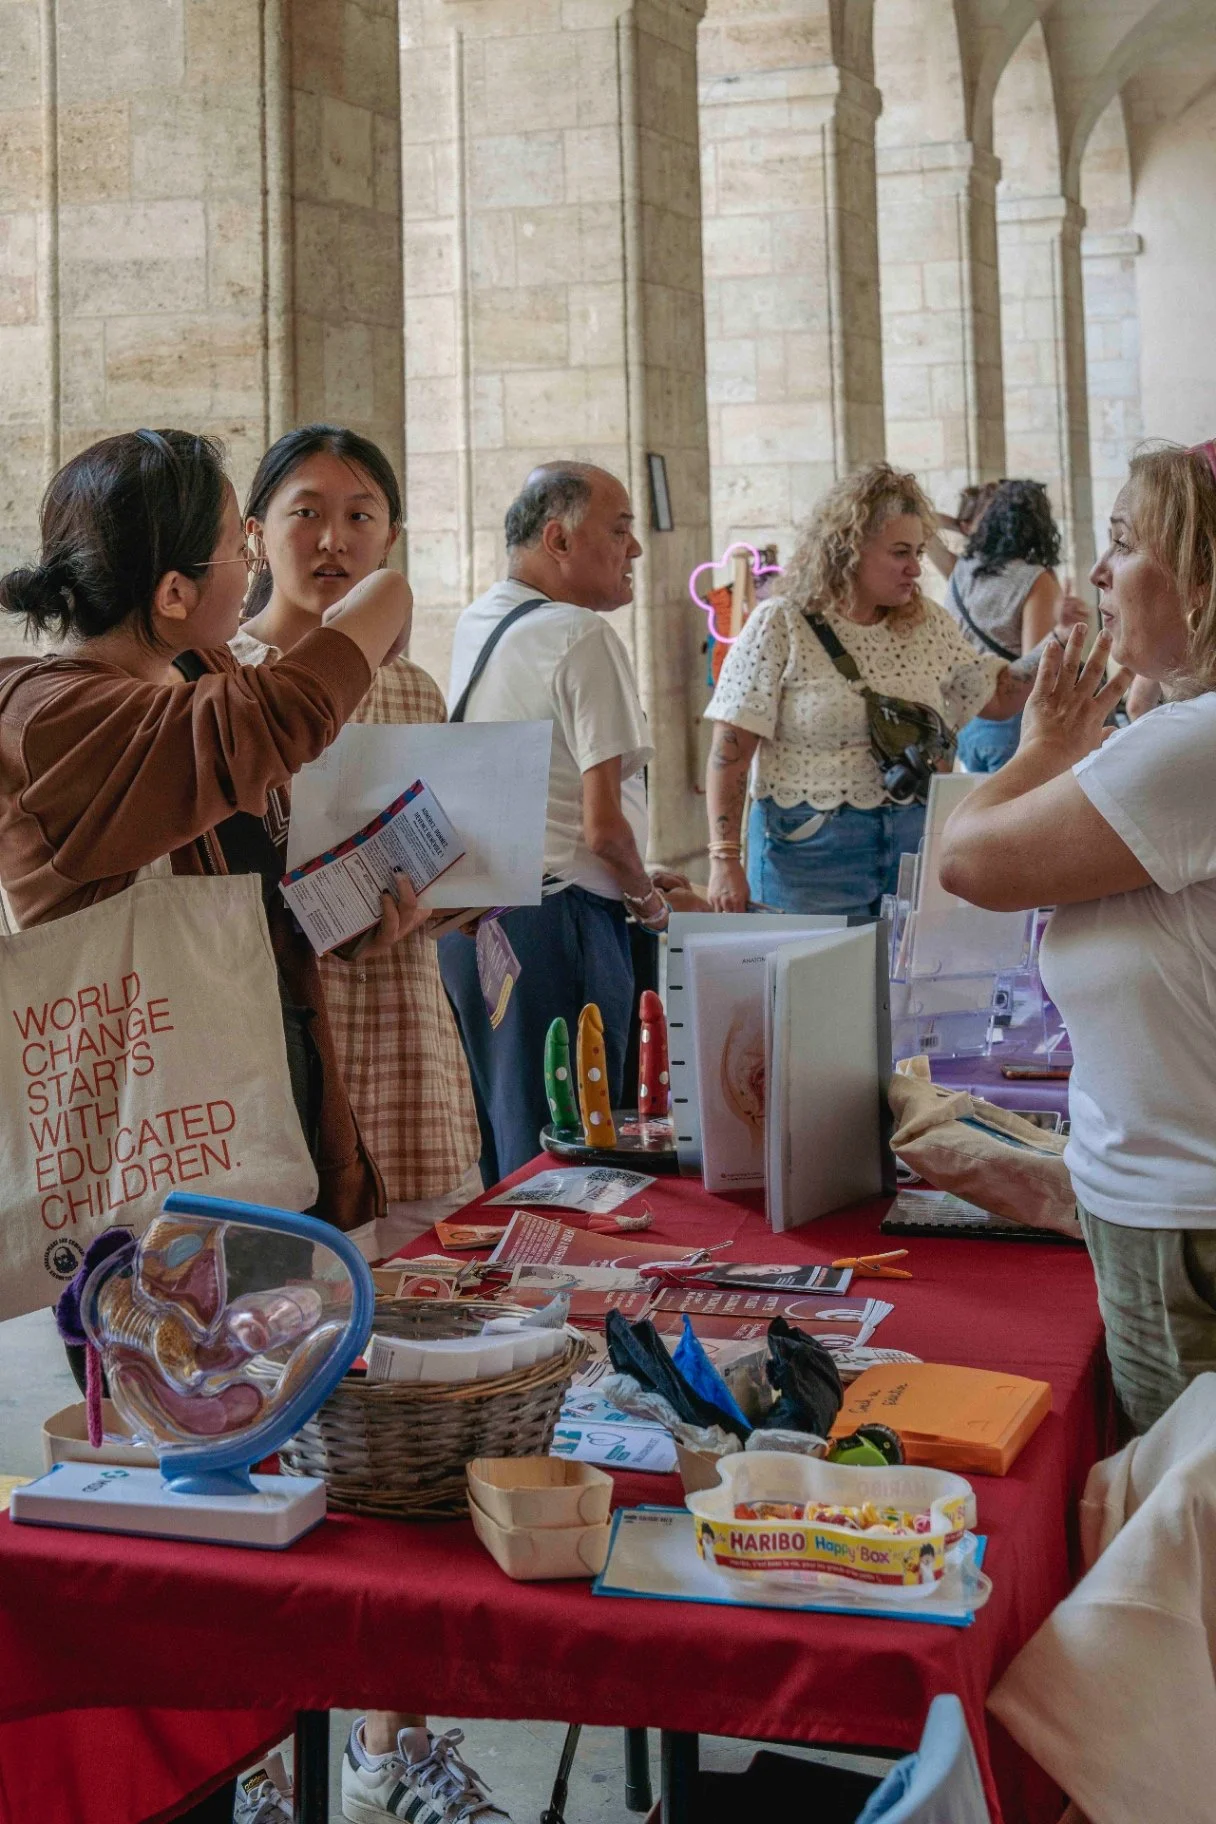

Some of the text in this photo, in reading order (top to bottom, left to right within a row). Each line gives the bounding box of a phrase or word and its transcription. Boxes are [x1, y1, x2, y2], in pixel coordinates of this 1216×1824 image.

[13, 971, 141, 1040] WORLD
[22, 997, 174, 1077] CHANGE
[27, 1040, 155, 1116] STARTS
[29, 1097, 120, 1152] WITH
[35, 1099, 236, 1193] EDUCATED
[41, 1139, 242, 1231] CHILDREN.
[730, 1531, 805, 1552] HARIBO
[815, 1535, 890, 1565] Happy Box
